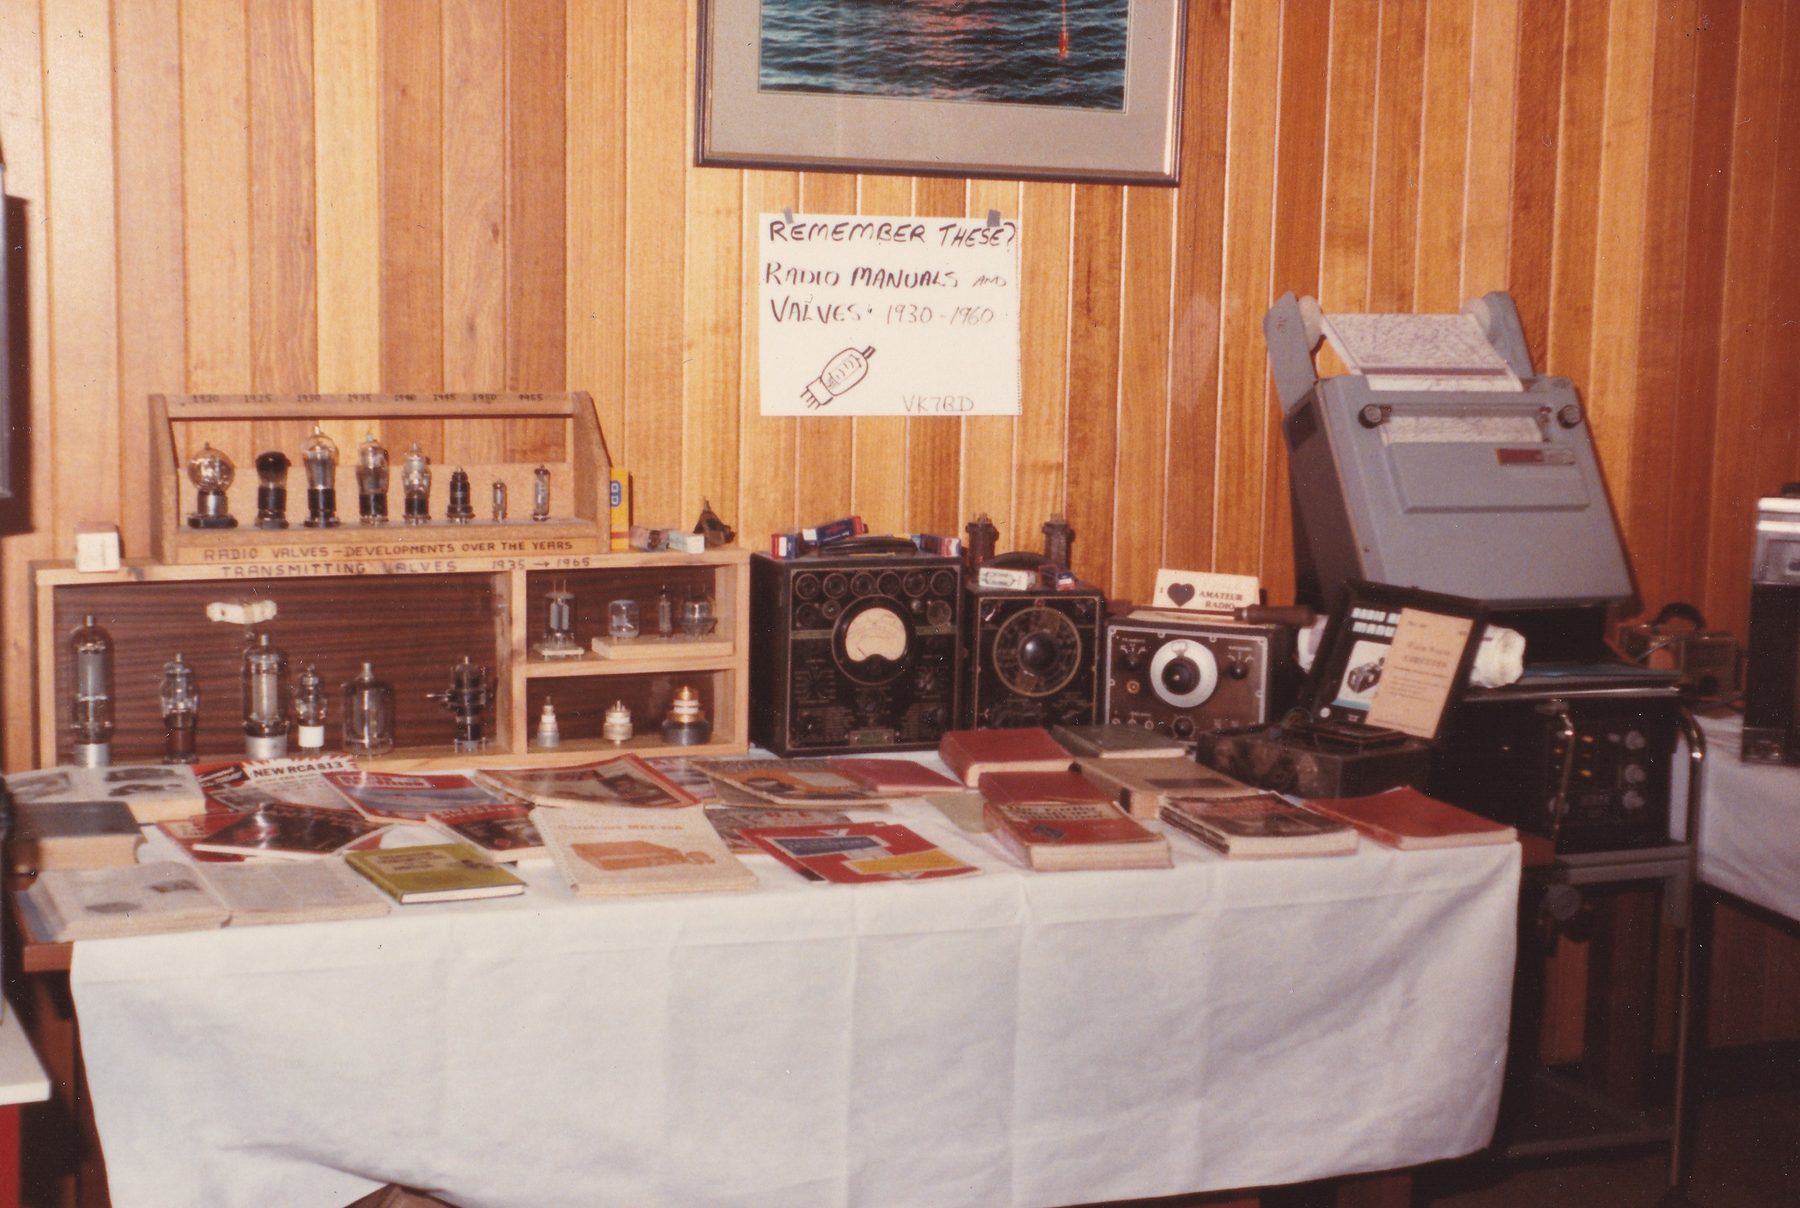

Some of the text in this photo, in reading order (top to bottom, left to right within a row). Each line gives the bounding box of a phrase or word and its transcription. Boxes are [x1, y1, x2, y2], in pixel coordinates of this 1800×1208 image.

[769, 220, 1016, 252] REMEMBER THESE?
[765, 261, 840, 286] RADIO
[850, 267, 959, 289] MANUALS
[886, 303, 933, 325] 1930
[950, 305, 994, 325] 1960
[472, 393, 496, 401] 1950
[203, 548, 259, 561] RADIO
[272, 546, 329, 559] VALVES
[461, 542, 496, 552] OVER
[502, 541, 526, 550] THE
[532, 540, 573, 551] YEARS
[221, 557, 591, 578] TRANSMITTING VALVES 1935 1965
[1199, 591, 1243, 601] AMATEUR
[1205, 601, 1236, 610] RADIO
[253, 766, 285, 778] NEW
[287, 763, 316, 775] RCA
[317, 761, 344, 771] 813
